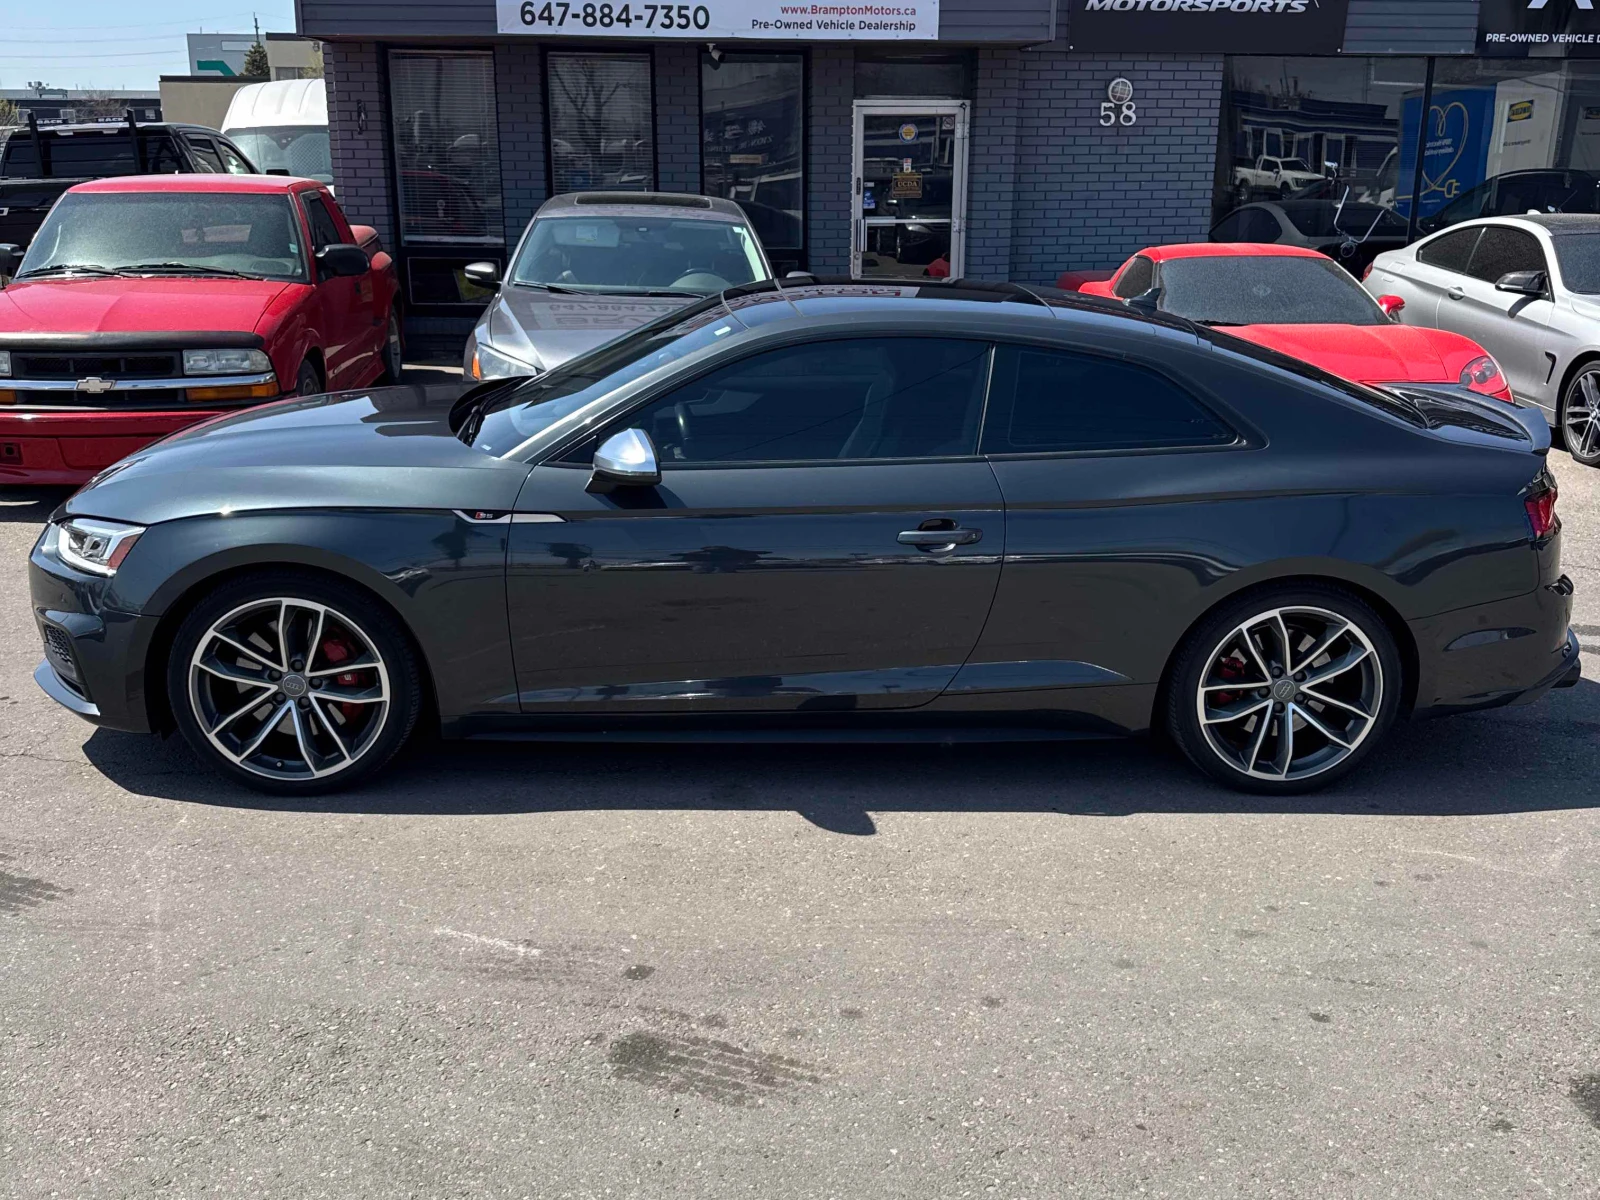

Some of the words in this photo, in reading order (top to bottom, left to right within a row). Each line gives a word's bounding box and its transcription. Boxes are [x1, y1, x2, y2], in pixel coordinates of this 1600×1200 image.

[780, 5, 917, 17] www.BramptonMotors.ca
[1085, 0, 1307, 12] MOTORSPORTS
[520, 1, 710, 30] 647-884-7350
[751, 19, 813, 30] Pre-Owned
[816, 19, 856, 30] Vehicle
[858, 20, 917, 32] Dealership
[1485, 33, 1550, 43] PRE-OWNED
[1552, 34, 1595, 43] VEHICLE
[1100, 101, 1137, 127] 58
